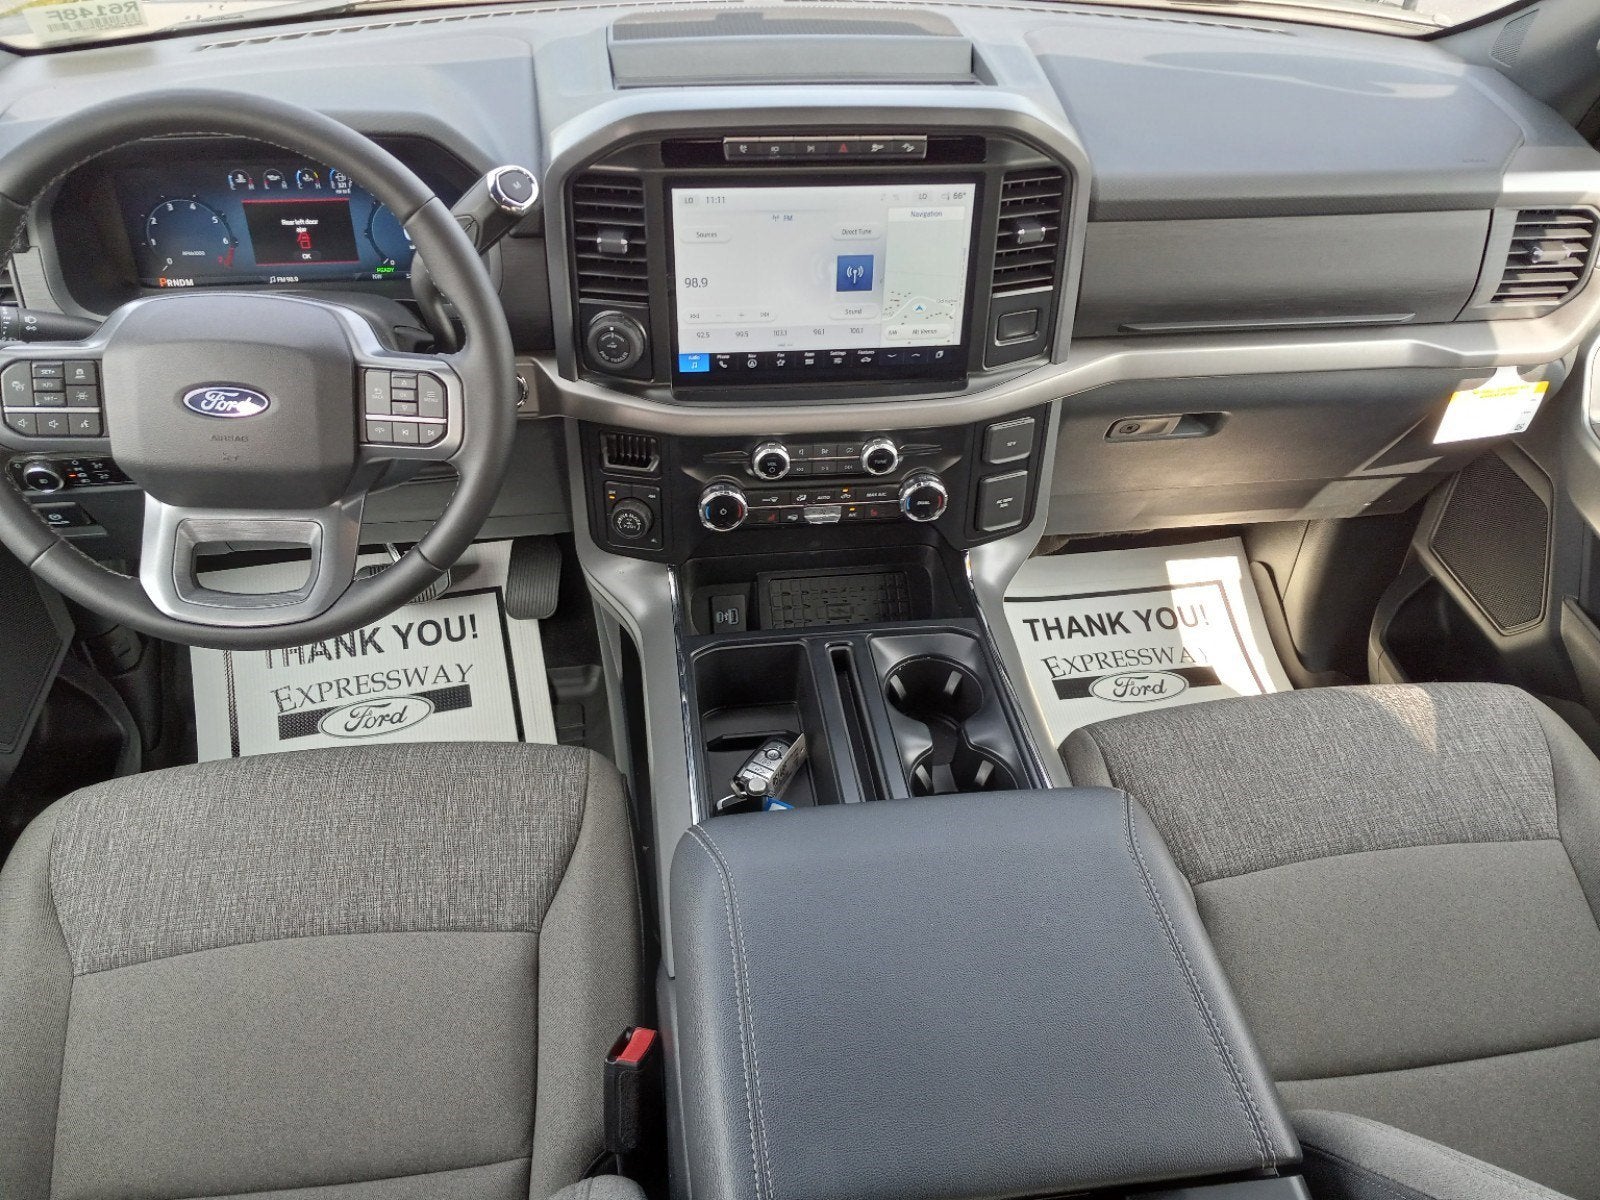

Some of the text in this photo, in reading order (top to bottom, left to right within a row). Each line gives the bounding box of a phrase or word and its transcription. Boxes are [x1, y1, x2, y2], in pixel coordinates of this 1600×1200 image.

[706, 196, 726, 204] 11:11
[910, 210, 943, 218] Navigation
[684, 277, 709, 289] 98.9
[845, 308, 863, 316] Sound
[696, 331, 711, 339] 92.5
[200, 390, 257, 412] Ford
[391, 613, 479, 650] YOU!
[1022, 604, 1211, 642] THANK YOU!
[270, 663, 475, 713] EXPRESSWAY
[1112, 675, 1168, 698] Ford
[343, 701, 409, 732] Ford
